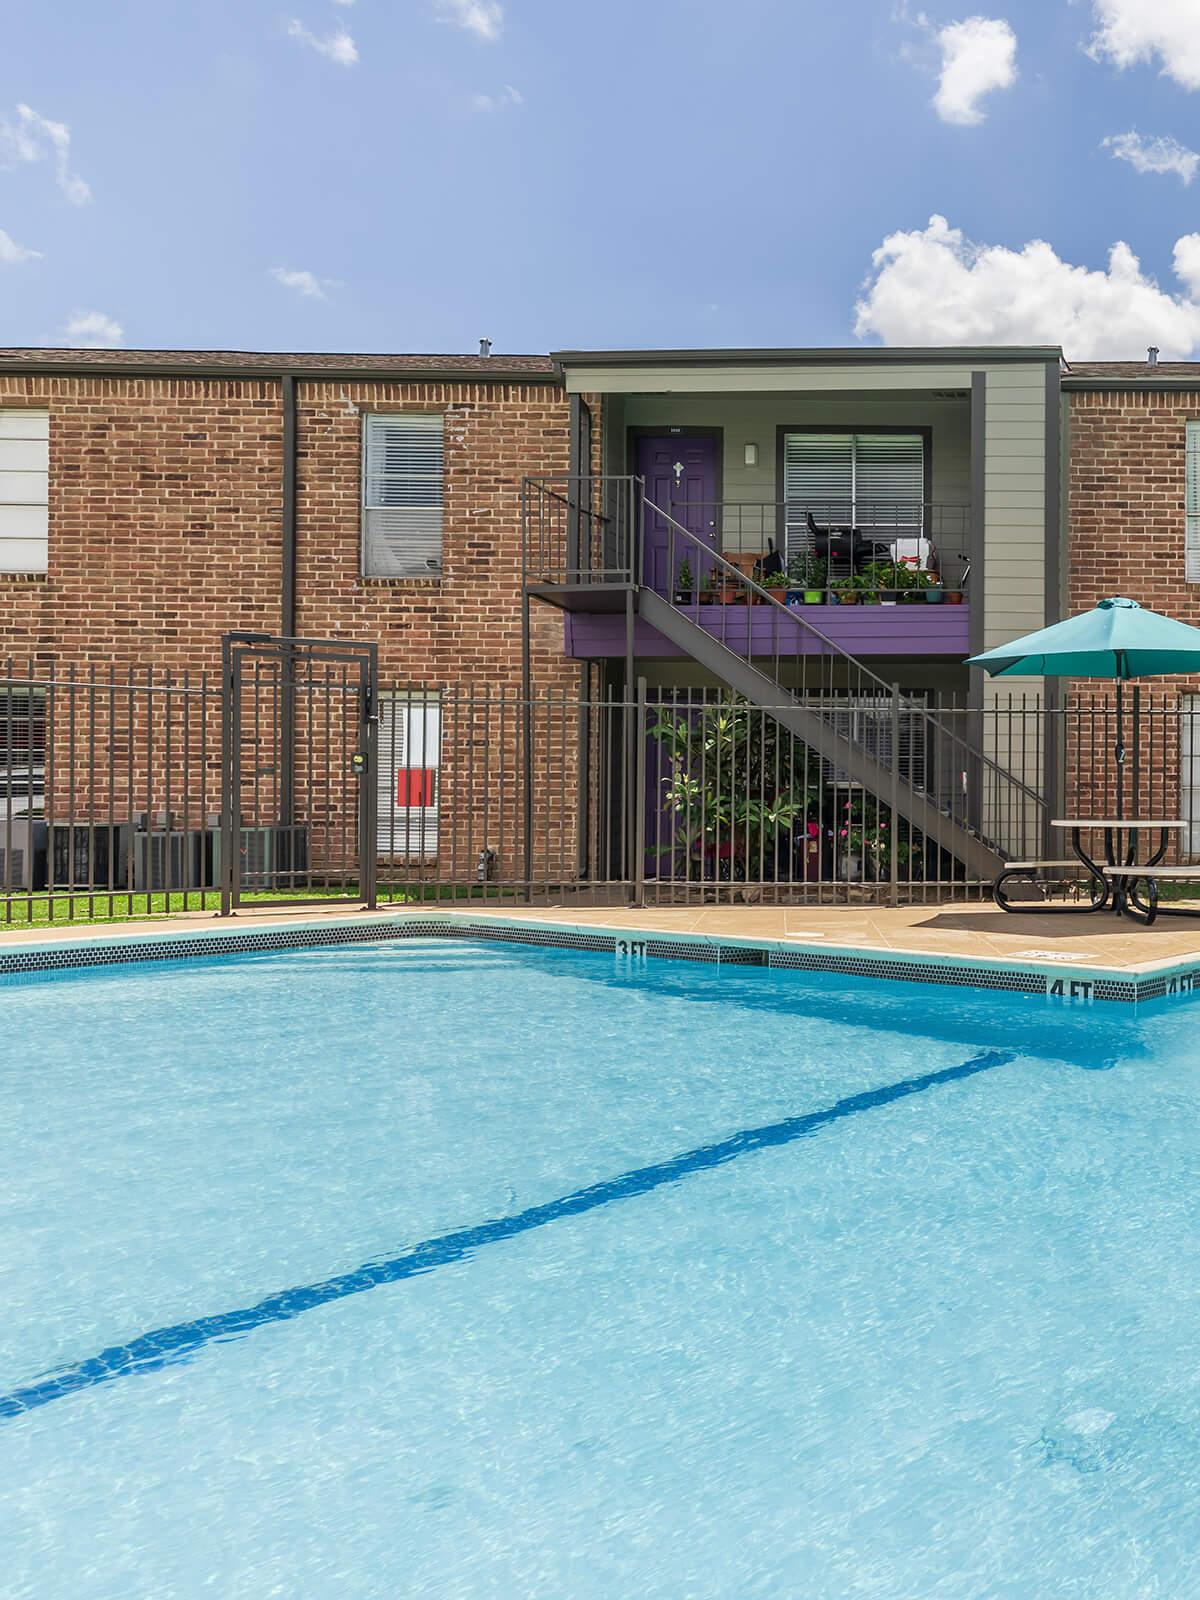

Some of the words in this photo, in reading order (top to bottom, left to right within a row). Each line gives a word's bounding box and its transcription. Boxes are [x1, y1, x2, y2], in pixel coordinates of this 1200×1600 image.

[618, 940, 628, 956] 3
[631, 941, 646, 956] FT
[1050, 979, 1066, 996] 4
[1070, 981, 1092, 998] FT
[1169, 978, 1177, 993] 4
[1181, 974, 1192, 992] FT
